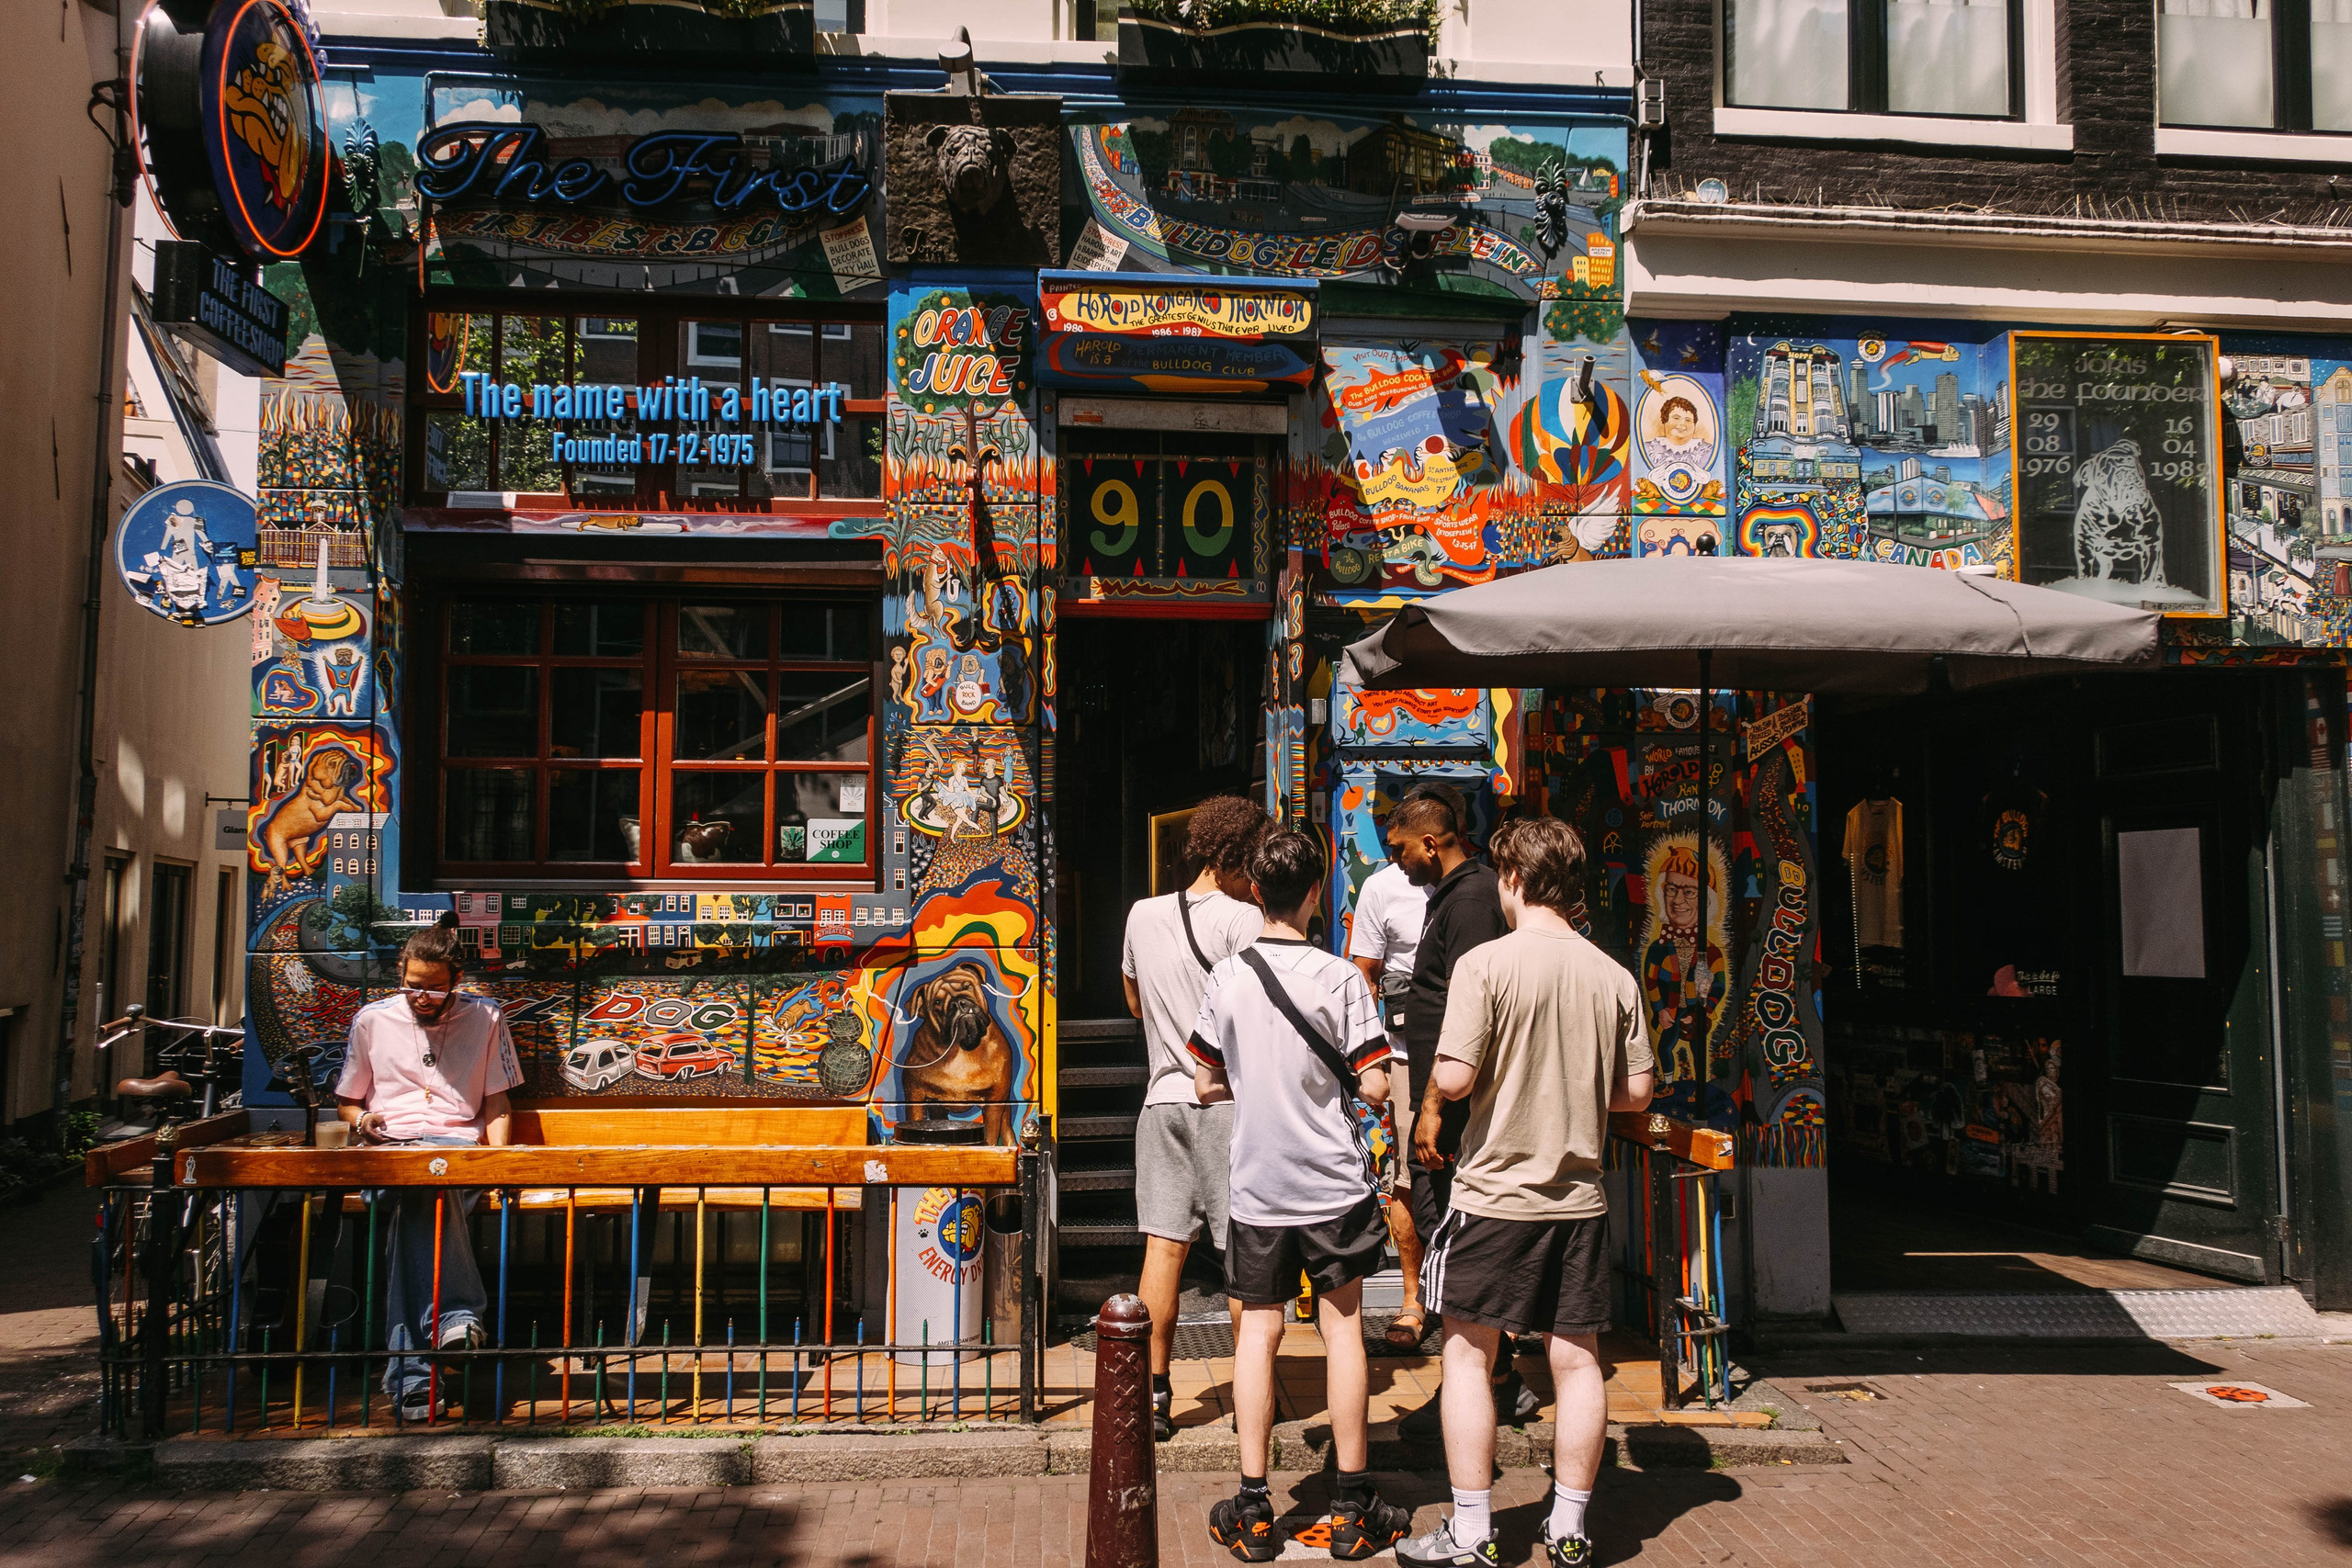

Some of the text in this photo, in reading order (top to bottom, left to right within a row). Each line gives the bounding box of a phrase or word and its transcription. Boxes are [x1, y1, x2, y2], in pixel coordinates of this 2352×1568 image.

[413, 121, 871, 214] The First
[1093, 180, 1128, 213] The
[564, 220, 670, 251] BEST
[657, 232, 687, 253] &
[844, 222, 865, 239] PRESS
[1086, 226, 1125, 250] STOP PRESS
[1125, 206, 1280, 266] BULLDOG
[1287, 225, 1530, 276] LEIDSPLEIN
[831, 246, 872, 267] DECORATE
[1073, 251, 1114, 272] LEIDSEPLEIN
[1081, 244, 1106, 262] BARRED
[1110, 248, 1123, 258] ART
[837, 258, 876, 274] CITY HALL
[212, 258, 280, 329] THE FIRST
[1048, 283, 1082, 293] PAINTED
[1076, 288, 1140, 326] HAROLD
[1225, 292, 1306, 324] THORNTON
[199, 290, 286, 368] COFFEESHOP
[913, 304, 1031, 348] ORANGE
[1063, 322, 1203, 338] 1980 1986 1987
[1129, 318, 1146, 327] THE
[1148, 311, 1187, 325] GREATEST
[1186, 310, 1217, 332] GENIUS
[1268, 322, 1295, 333] LIVED
[1074, 339, 1287, 362] HAROLD PERMANENT MEMBER
[1352, 351, 1371, 363] VISIT
[1372, 348, 1389, 361] OUR
[1787, 351, 1815, 360] HOPPE
[909, 352, 1021, 396] JUICE
[1152, 358, 1213, 373] BULLDOG
[1221, 365, 1256, 377] CLUB
[1350, 391, 1364, 400] The
[1363, 377, 1401, 396] BULLDOG
[1442, 365, 1456, 377] BAR
[459, 371, 842, 423] The name with a heart
[1347, 398, 1363, 408] OUDE
[1366, 418, 1406, 440] BULLDOG
[1407, 410, 1438, 423] COFFEE
[1440, 410, 1462, 421] SHOP
[1424, 423, 1430, 433] 7
[2028, 412, 2194, 434] 29 16
[552, 431, 754, 466] Founded 17-12-1975
[2026, 435, 2199, 458] 08 04
[2018, 457, 2211, 481] 1976 1989
[1364, 474, 1398, 496] BULLDOG
[1395, 481, 1430, 494] BANANAS
[1435, 485, 1447, 494] 77
[1329, 507, 1359, 522] BULLDOG
[1358, 516, 1380, 525] COFFEE
[1380, 514, 1397, 525] SHOP
[1416, 514, 1431, 524] SHOP
[1331, 520, 1351, 532] Palace
[1433, 513, 1479, 529] SPORTS WEAR
[1440, 513, 1451, 522] ALL
[1368, 538, 1424, 565] RENT A BIKE
[1876, 537, 1984, 571] CANADA
[1335, 559, 1362, 575] BULLDOG
[1363, 690, 1380, 698] THERE
[1402, 690, 1426, 706] ABSTRACT
[1384, 697, 1399, 705] MUST
[1442, 705, 1469, 714] SOMETHING
[1642, 741, 1655, 753] This
[1645, 744, 1701, 763] WORLD FAMOUS
[1749, 732, 1781, 759] AUSSIE
[1644, 764, 1655, 776] BY
[1642, 761, 1701, 803] HAROLD
[1660, 797, 1726, 821] THORNON
[811, 829, 861, 840] COFFEE
[820, 840, 854, 850] SHOP
[820, 928, 848, 936] THEATER
[1755, 860, 1807, 1067] BULLDOG
[2028, 985, 2058, 996] LARGE
[913, 1187, 950, 1225] THE
